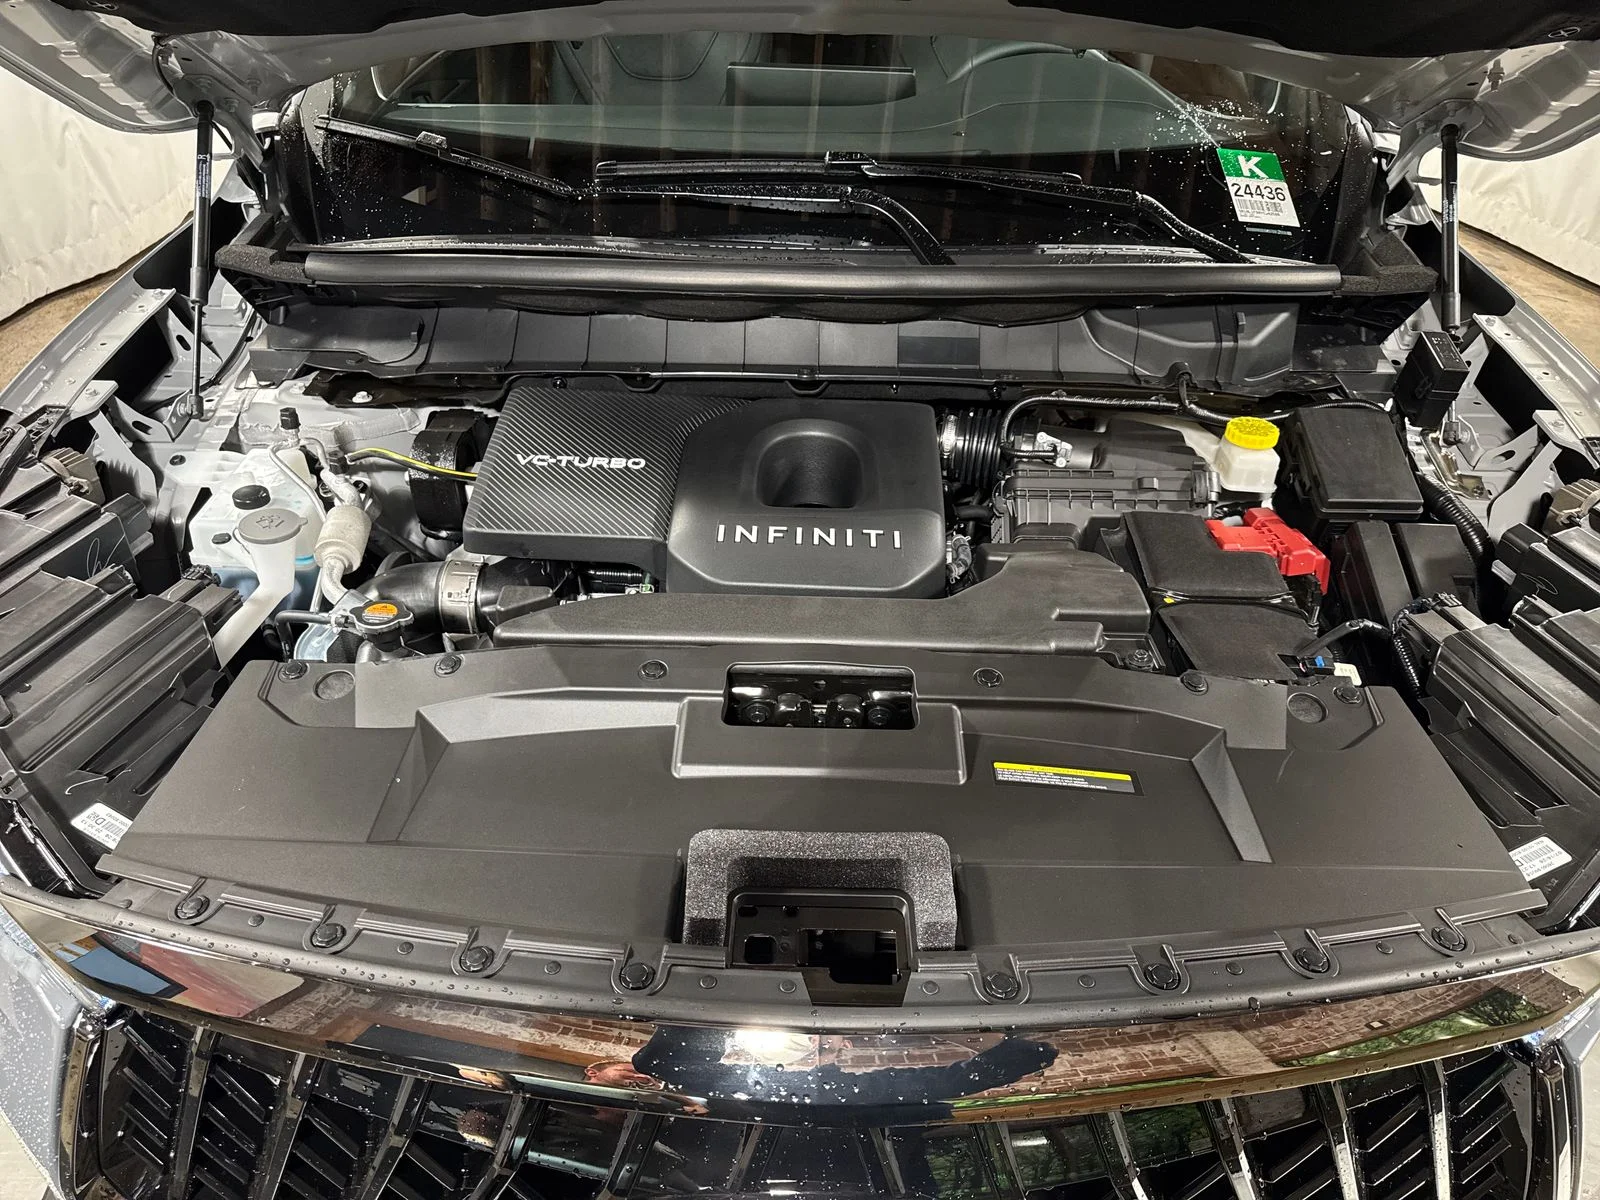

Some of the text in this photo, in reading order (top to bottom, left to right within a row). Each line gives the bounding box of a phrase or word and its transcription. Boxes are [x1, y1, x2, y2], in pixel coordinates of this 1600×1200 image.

[1238, 155, 1269, 178] K
[1231, 183, 1286, 201] 24436
[516, 453, 646, 470] VC-TURBO
[716, 524, 902, 549] INFINITI
